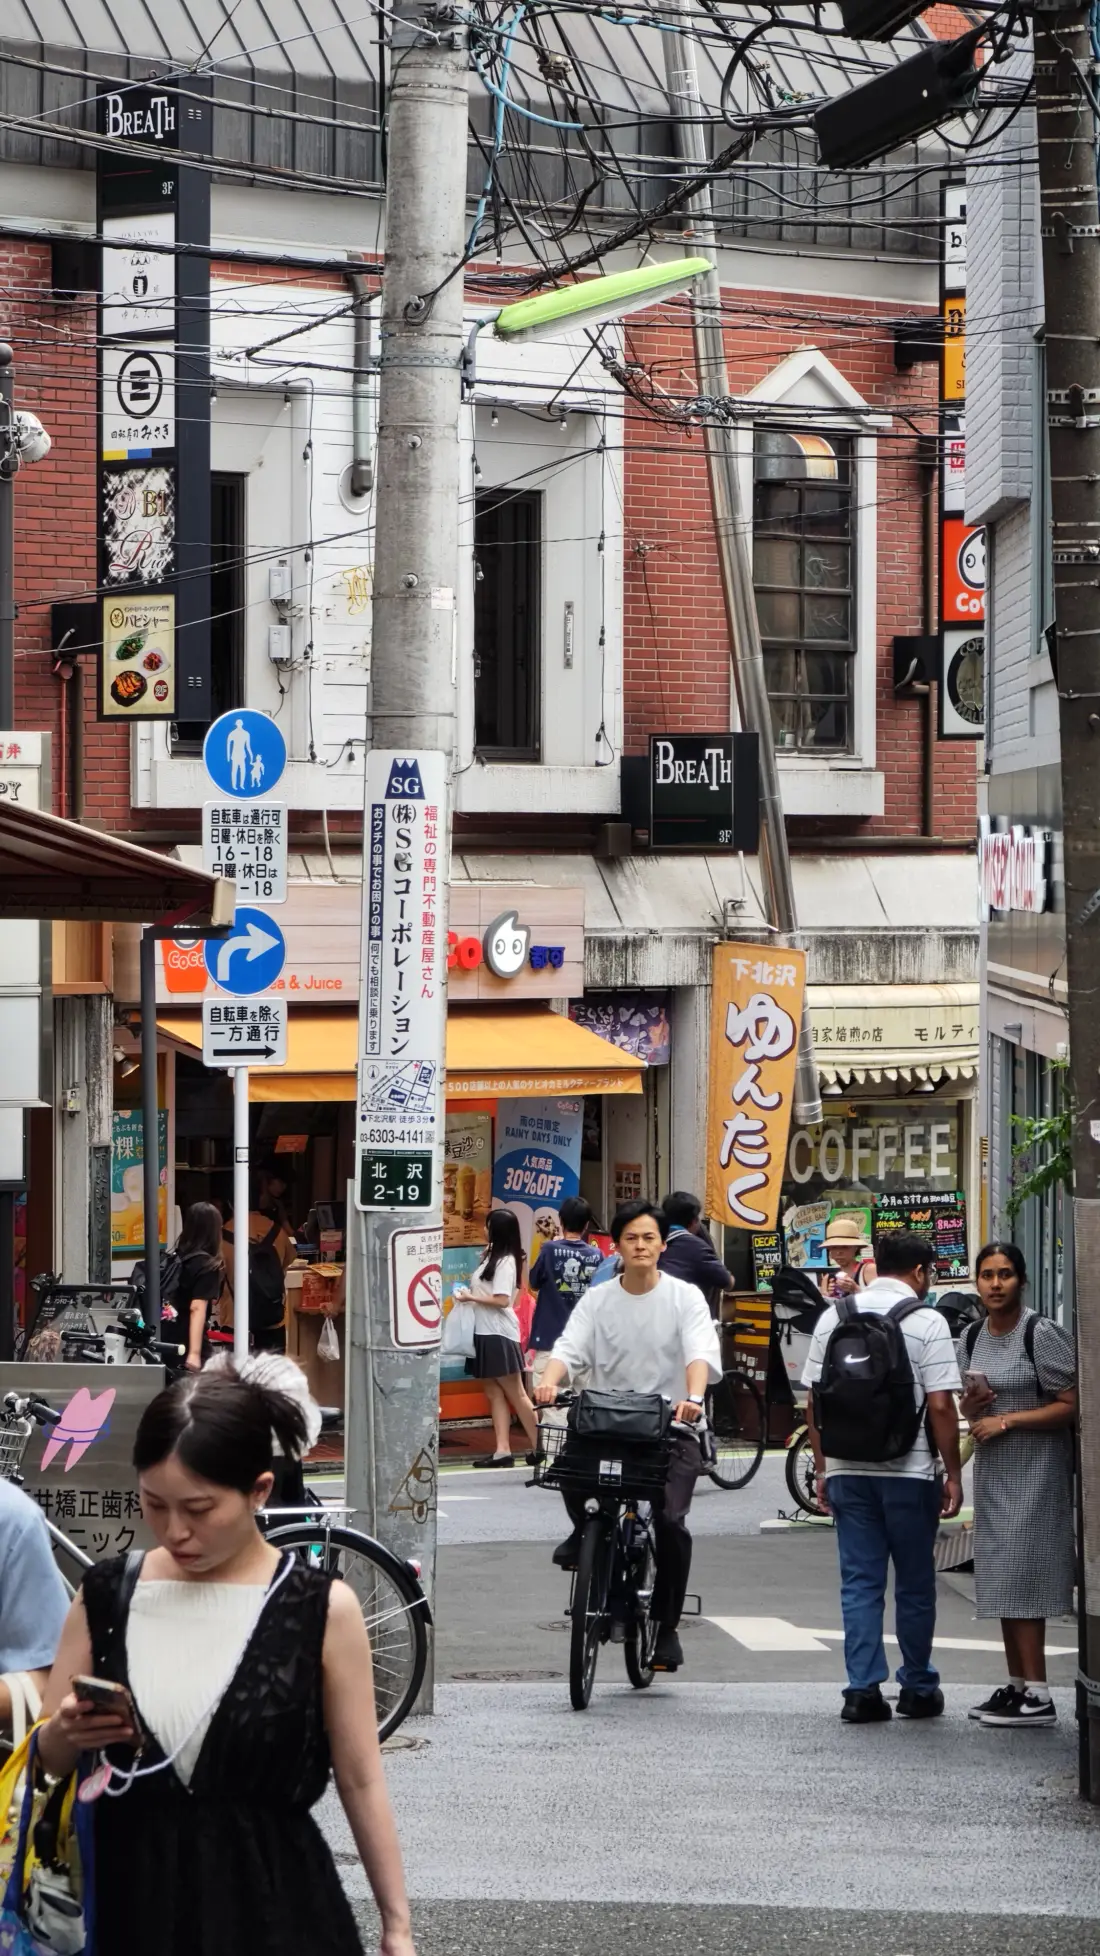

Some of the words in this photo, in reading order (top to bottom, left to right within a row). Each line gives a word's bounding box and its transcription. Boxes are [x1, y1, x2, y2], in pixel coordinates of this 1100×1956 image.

[162, 181, 174, 194] 3F
[142, 489, 168, 517] B1
[154, 684, 168, 697] 2F
[656, 741, 732, 791] BREATH
[391, 776, 420, 795] SG
[210, 808, 281, 825] 自転車は通行可
[210, 828, 281, 845] 日曜・休日を除く
[719, 830, 732, 843] 3F
[420, 805, 438, 999] 福祉の専門不動産屋さん
[730, 958, 797, 987] 下北沢
[289, 975, 300, 990] &
[304, 975, 343, 990] Juice
[368, 943, 380, 1052] 何でも相談に乗ります
[210, 1006, 281, 1023] 自転車を除く
[210, 1025, 280, 1042] 一方通行
[914, 1024, 980, 1042] モルティ
[720, 992, 797, 1226] ゆんたく
[520, 1115, 560, 1133] 雨の日限定
[360, 1129, 424, 1144] 03-6303-4141
[505, 1126, 529, 1140] RAINY
[532, 1131, 551, 1145] DAYS
[553, 1136, 573, 1148] ONLY
[522, 1154, 553, 1171] 人気商品
[789, 1124, 950, 1184] COFFEE
[503, 1167, 564, 1198] 30%OFF
[373, 1184, 420, 1201] 2-19
[754, 1236, 778, 1248] DECAF
[23, 1488, 144, 1520] 井矯正歯科
